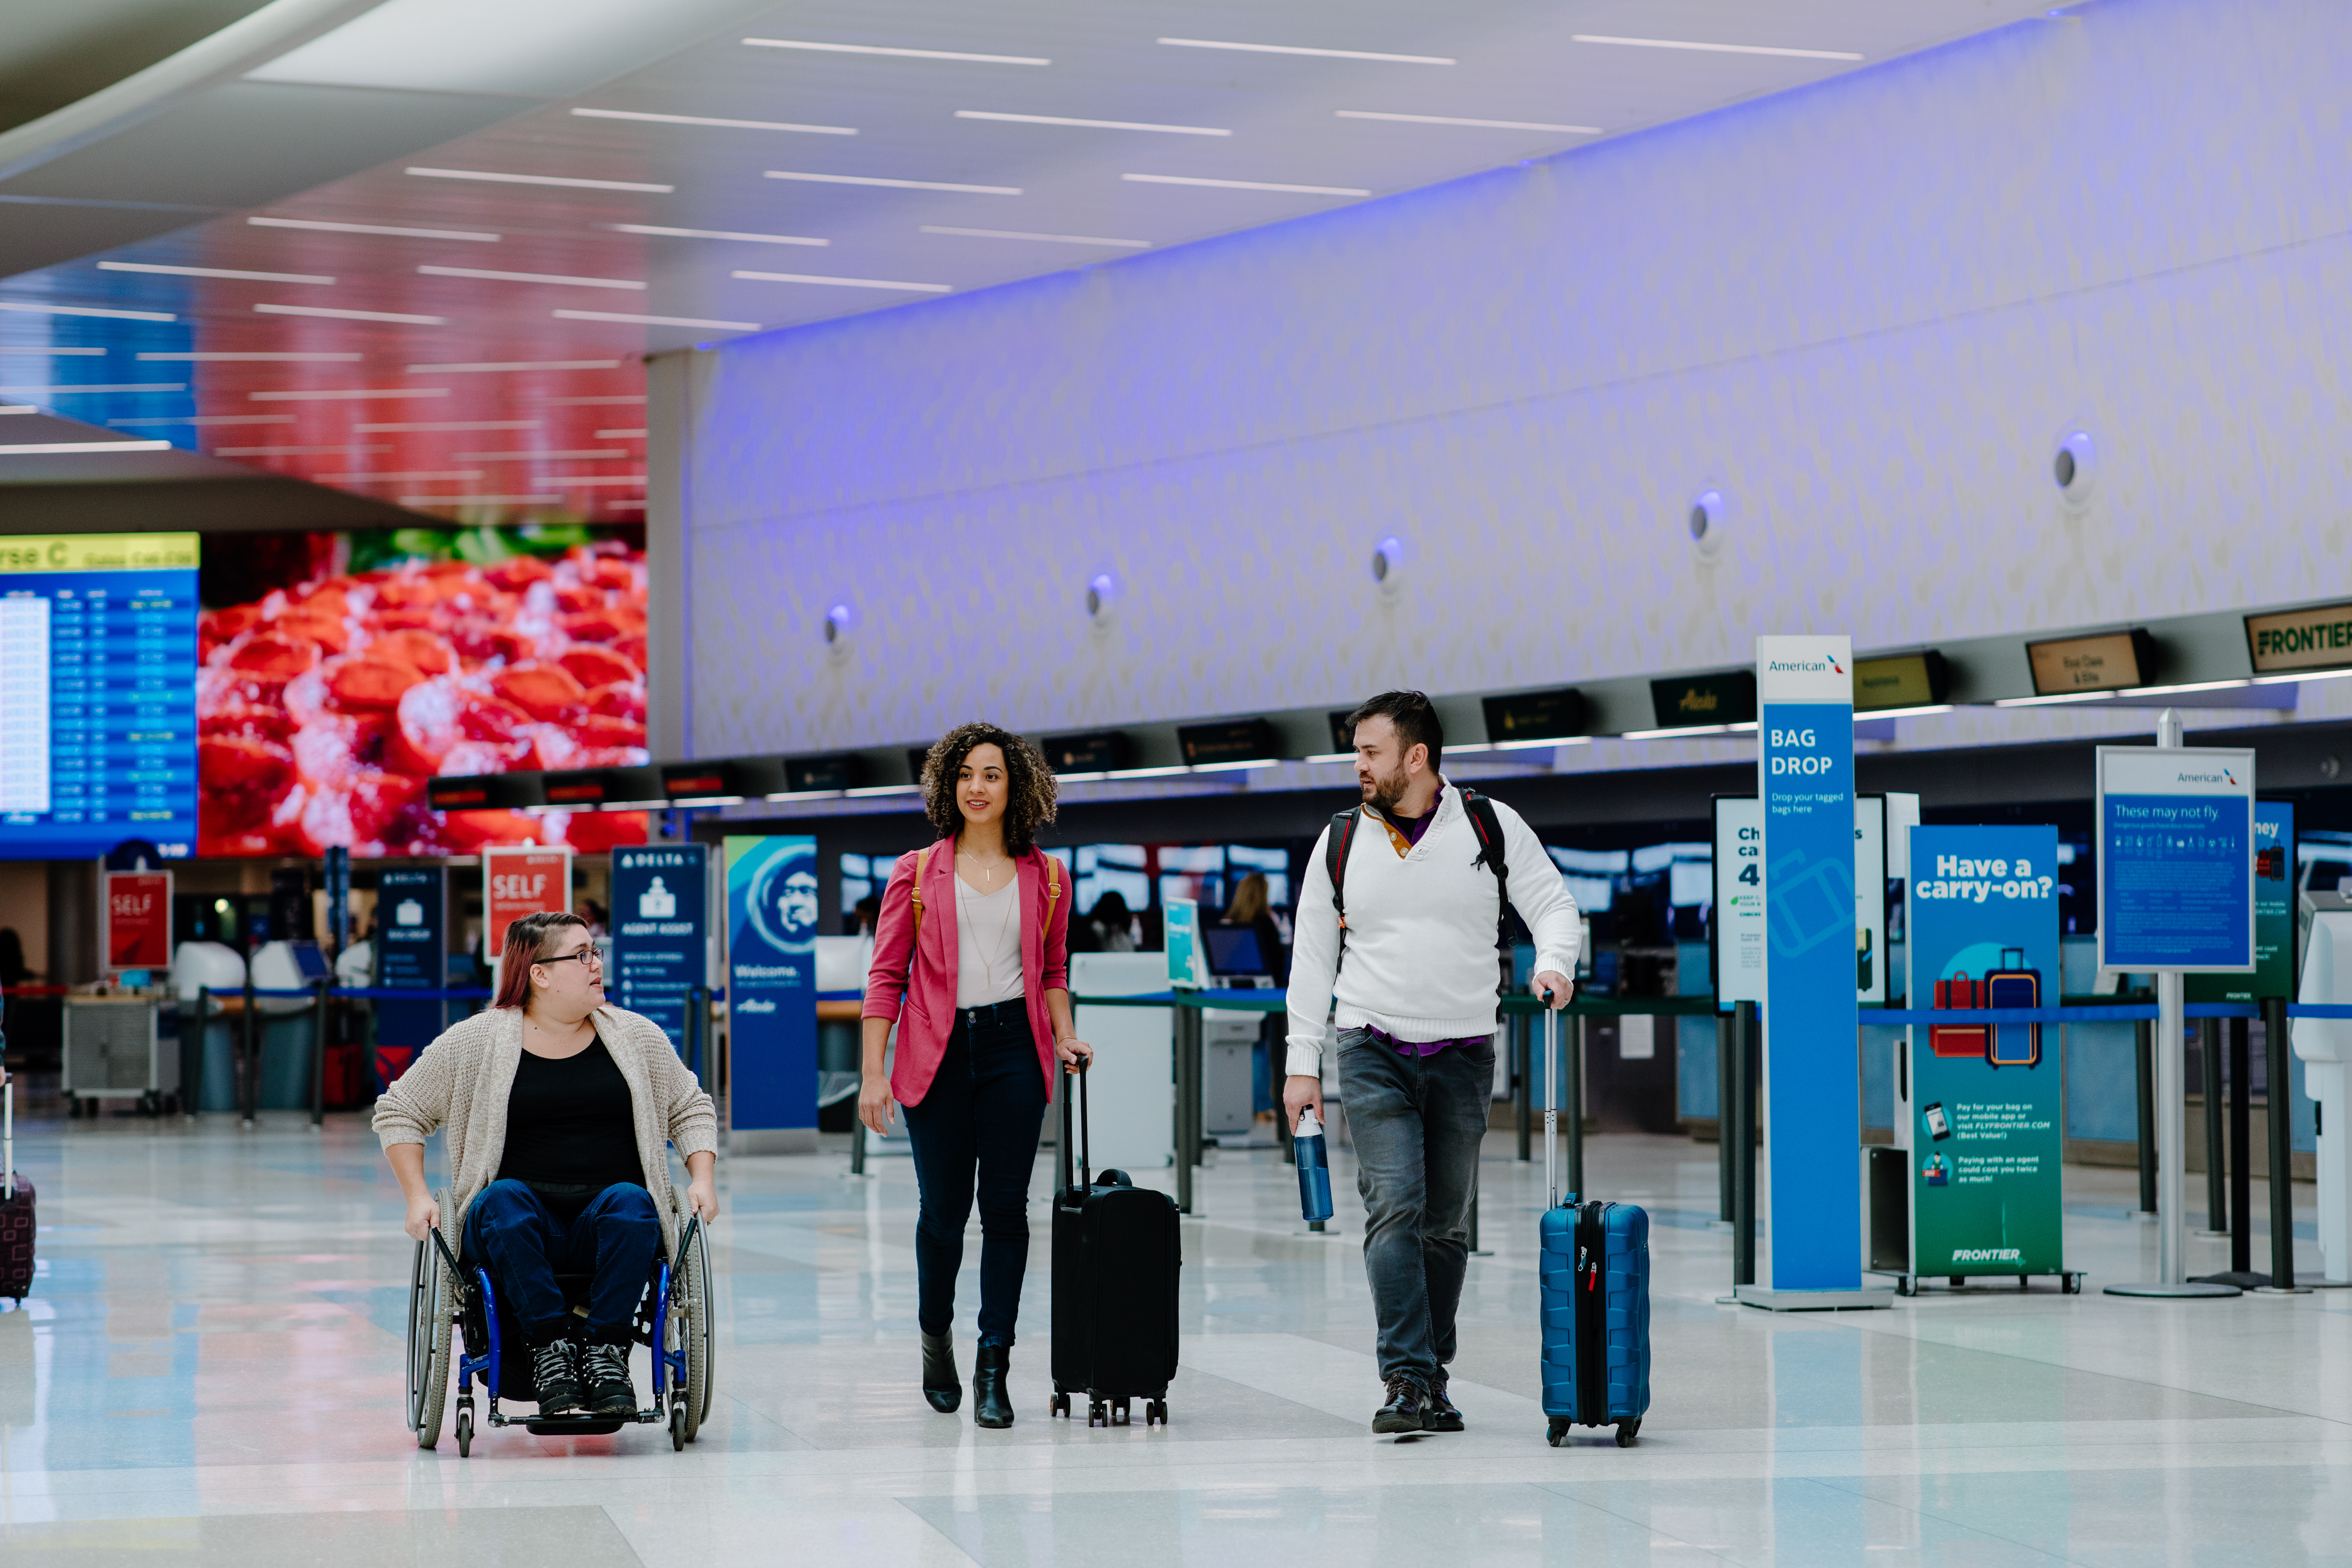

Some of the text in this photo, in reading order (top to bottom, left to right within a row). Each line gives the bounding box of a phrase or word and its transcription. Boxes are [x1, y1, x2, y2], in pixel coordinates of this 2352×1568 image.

[1769, 660, 1825, 671] American
[1771, 729, 1815, 747] BAG
[1771, 757, 1832, 775] DROP
[2177, 773, 2223, 782] American
[1772, 792, 1844, 804] Drop your tagged
[1772, 804, 1812, 816] bags here
[2115, 804, 2220, 822] These may not fly.
[635, 853, 684, 866] DELTA
[1937, 855, 2031, 877] Have a
[492, 874, 547, 900] SELF
[1916, 876, 2052, 903] carry-on?
[112, 894, 152, 916] SELF
[1957, 1103, 1971, 1112] Pay
[1973, 1102, 1984, 1111] for
[2005, 1103, 2020, 1112] bag
[1957, 1121, 2050, 1130] visit FLYFRONTIER.COM
[1957, 1131, 2007, 1140] (Best Value!)
[1958, 1155, 1984, 1164] Paying
[2017, 1155, 2039, 1164] agent
[1969, 1175, 1992, 1183] much!
[1952, 1249, 2020, 1261] FRONTIER
